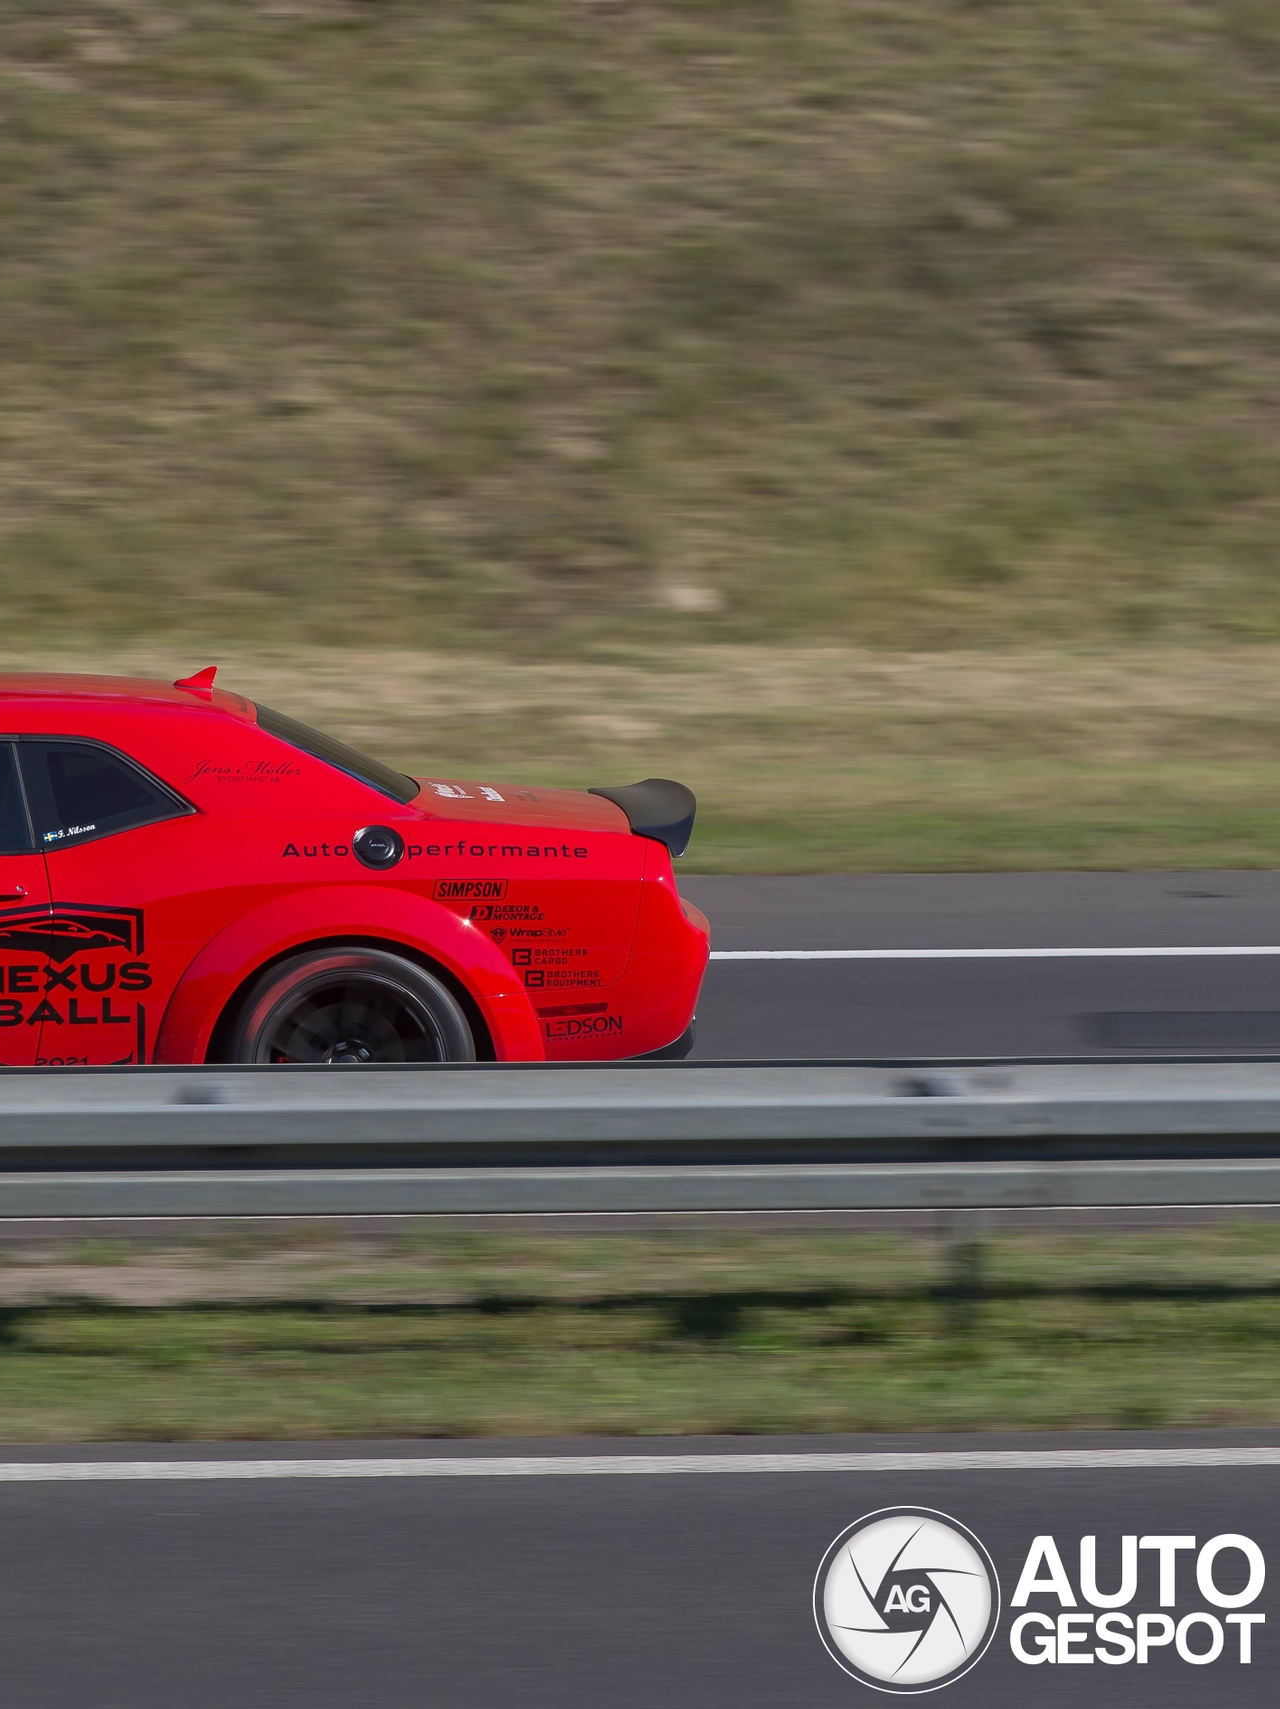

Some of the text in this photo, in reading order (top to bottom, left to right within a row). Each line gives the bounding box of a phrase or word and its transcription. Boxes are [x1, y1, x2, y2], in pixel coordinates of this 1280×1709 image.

[182, 759, 302, 784] Jens Möller
[281, 842, 349, 858] Auto
[407, 841, 588, 860] performante
[437, 881, 503, 898] SIMPSON
[493, 905, 530, 913] DEKOR
[531, 905, 540, 913] &
[492, 913, 545, 921] MONTAGE
[534, 957, 568, 965] CARGO
[547, 970, 600, 978] BROTHERS
[547, 978, 602, 987] EQUIPMENT
[546, 1015, 623, 1038] LEDSON
